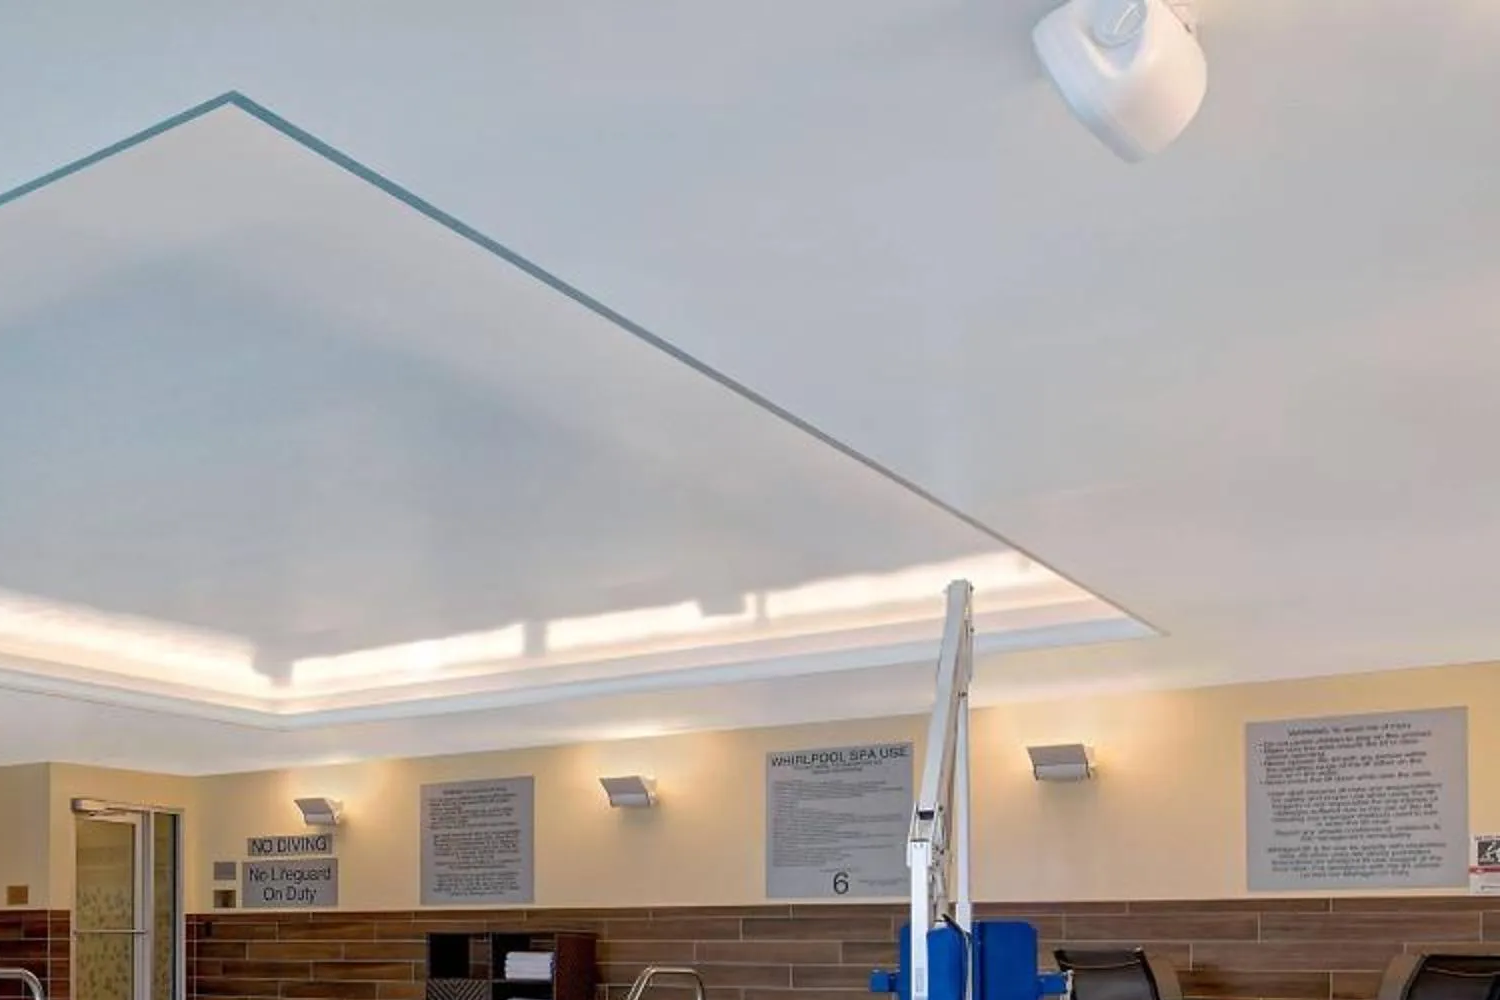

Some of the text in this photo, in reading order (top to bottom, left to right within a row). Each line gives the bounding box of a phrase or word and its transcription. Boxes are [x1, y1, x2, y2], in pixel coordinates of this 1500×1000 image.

[772, 746, 909, 767] WHIRLPOOL SPA USE
[251, 835, 327, 853] NO DIVING
[249, 866, 331, 884] No Lifeguard
[833, 871, 849, 894] 6
[263, 886, 317, 904] On Duty
